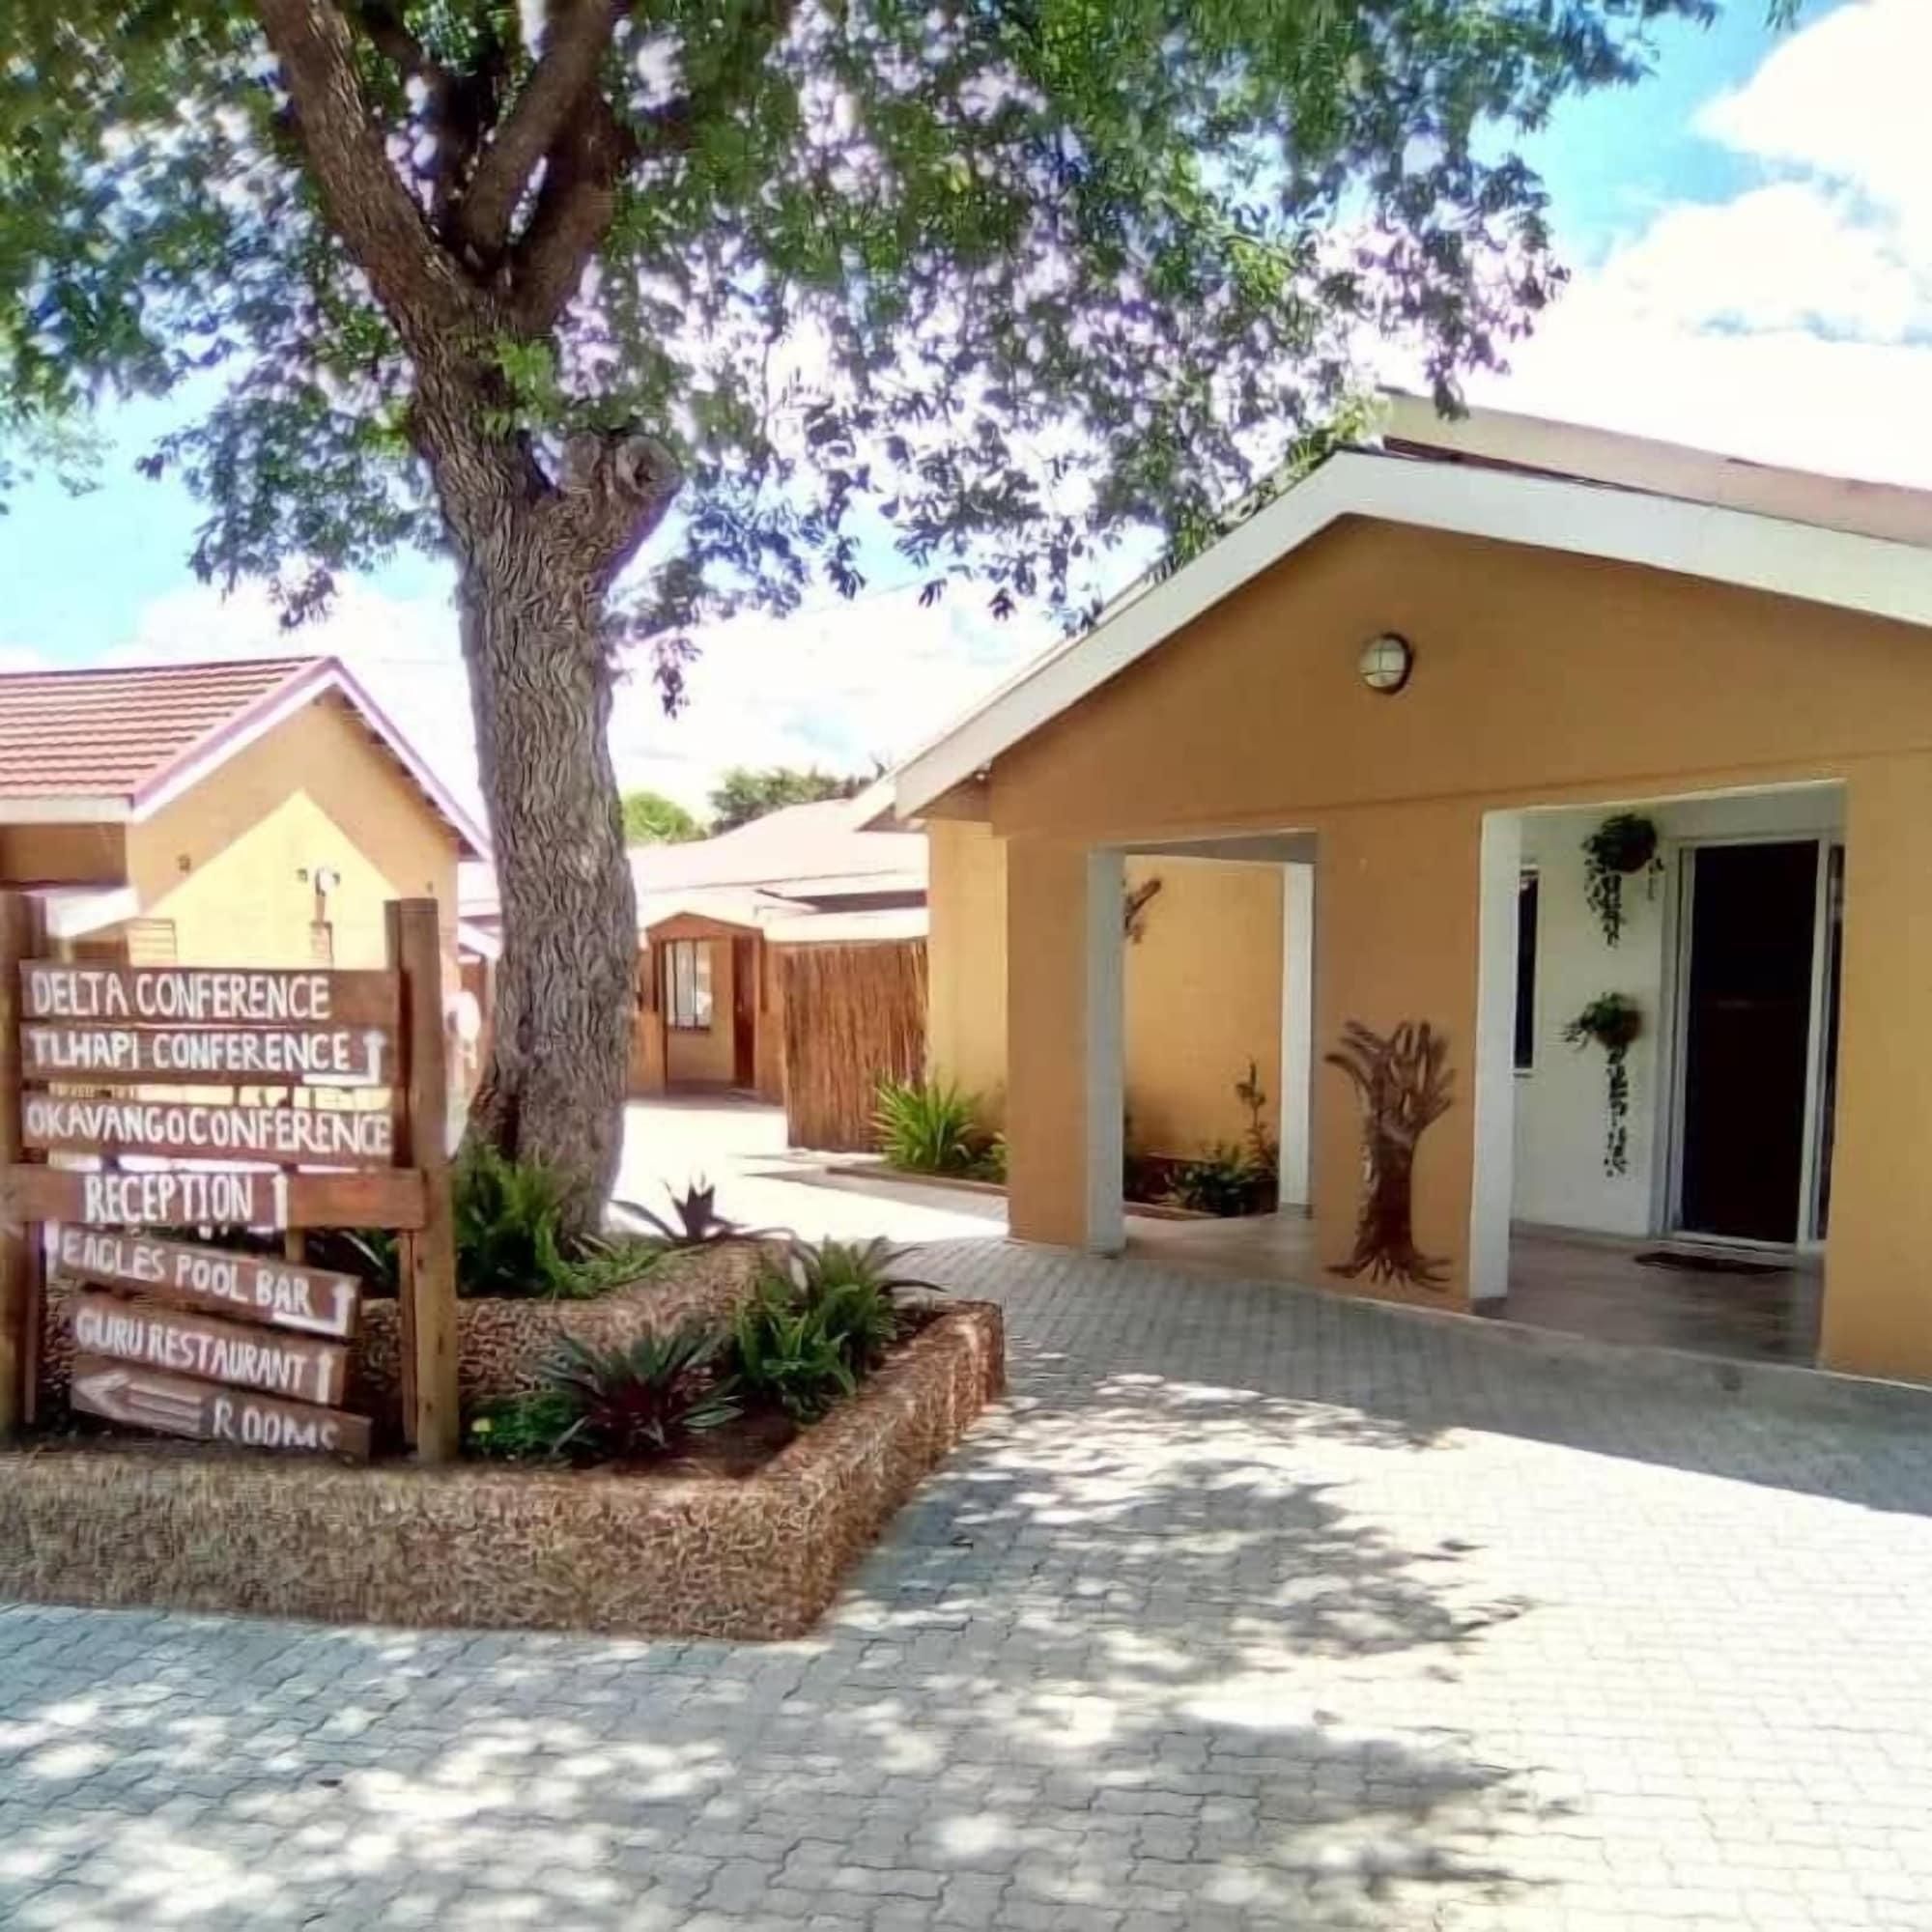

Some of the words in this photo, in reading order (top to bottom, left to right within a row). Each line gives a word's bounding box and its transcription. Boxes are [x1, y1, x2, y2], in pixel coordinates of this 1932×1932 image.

[31, 972, 130, 1016] DELTA
[136, 973, 332, 1020] CONFERENCE
[31, 1030, 138, 1068] TLHAPI
[153, 1031, 352, 1071] CONFERENCE
[84, 1173, 253, 1223] RECEPTION
[61, 1229, 166, 1281] EAGLES
[174, 1253, 247, 1303] POOL
[255, 1268, 313, 1317] BAR
[75, 1307, 146, 1355] GURU
[148, 1327, 307, 1391] RESTAURANT
